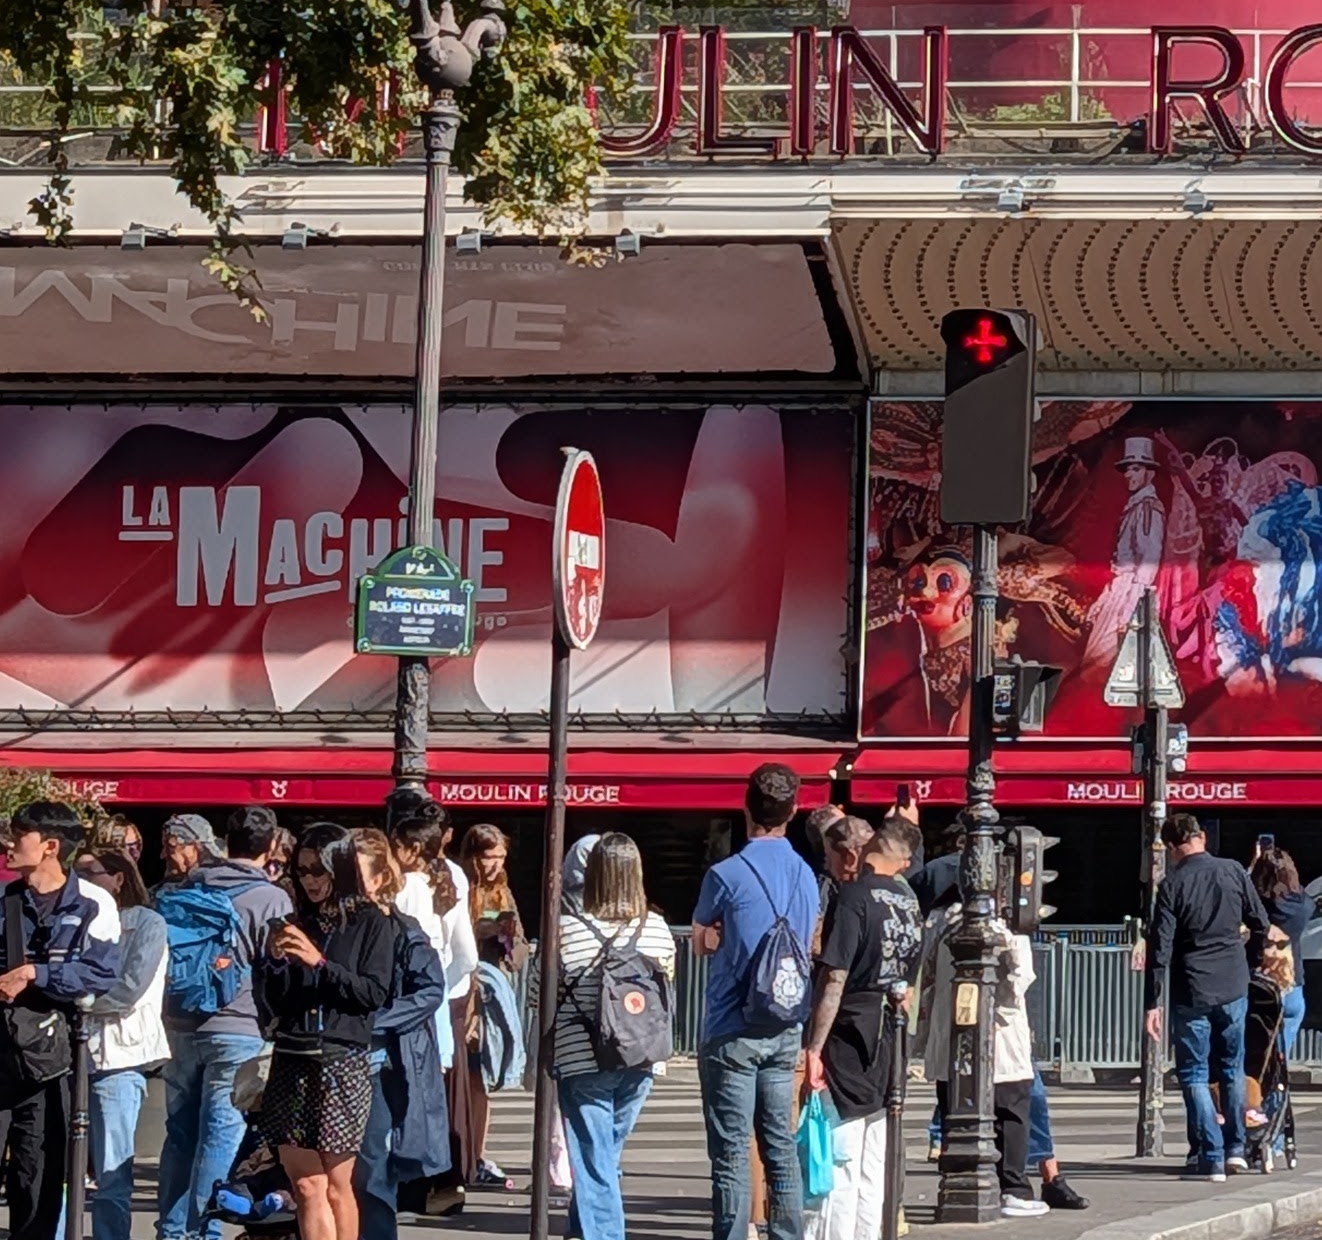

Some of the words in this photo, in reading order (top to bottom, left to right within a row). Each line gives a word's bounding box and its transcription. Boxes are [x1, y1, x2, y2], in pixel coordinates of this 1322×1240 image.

[257, 24, 948, 157] ULIN
[121, 485, 171, 527] LA
[440, 783, 531, 801] MOULIN
[1067, 782, 1144, 800] MOULI
[1165, 782, 1248, 800] ROUGE
